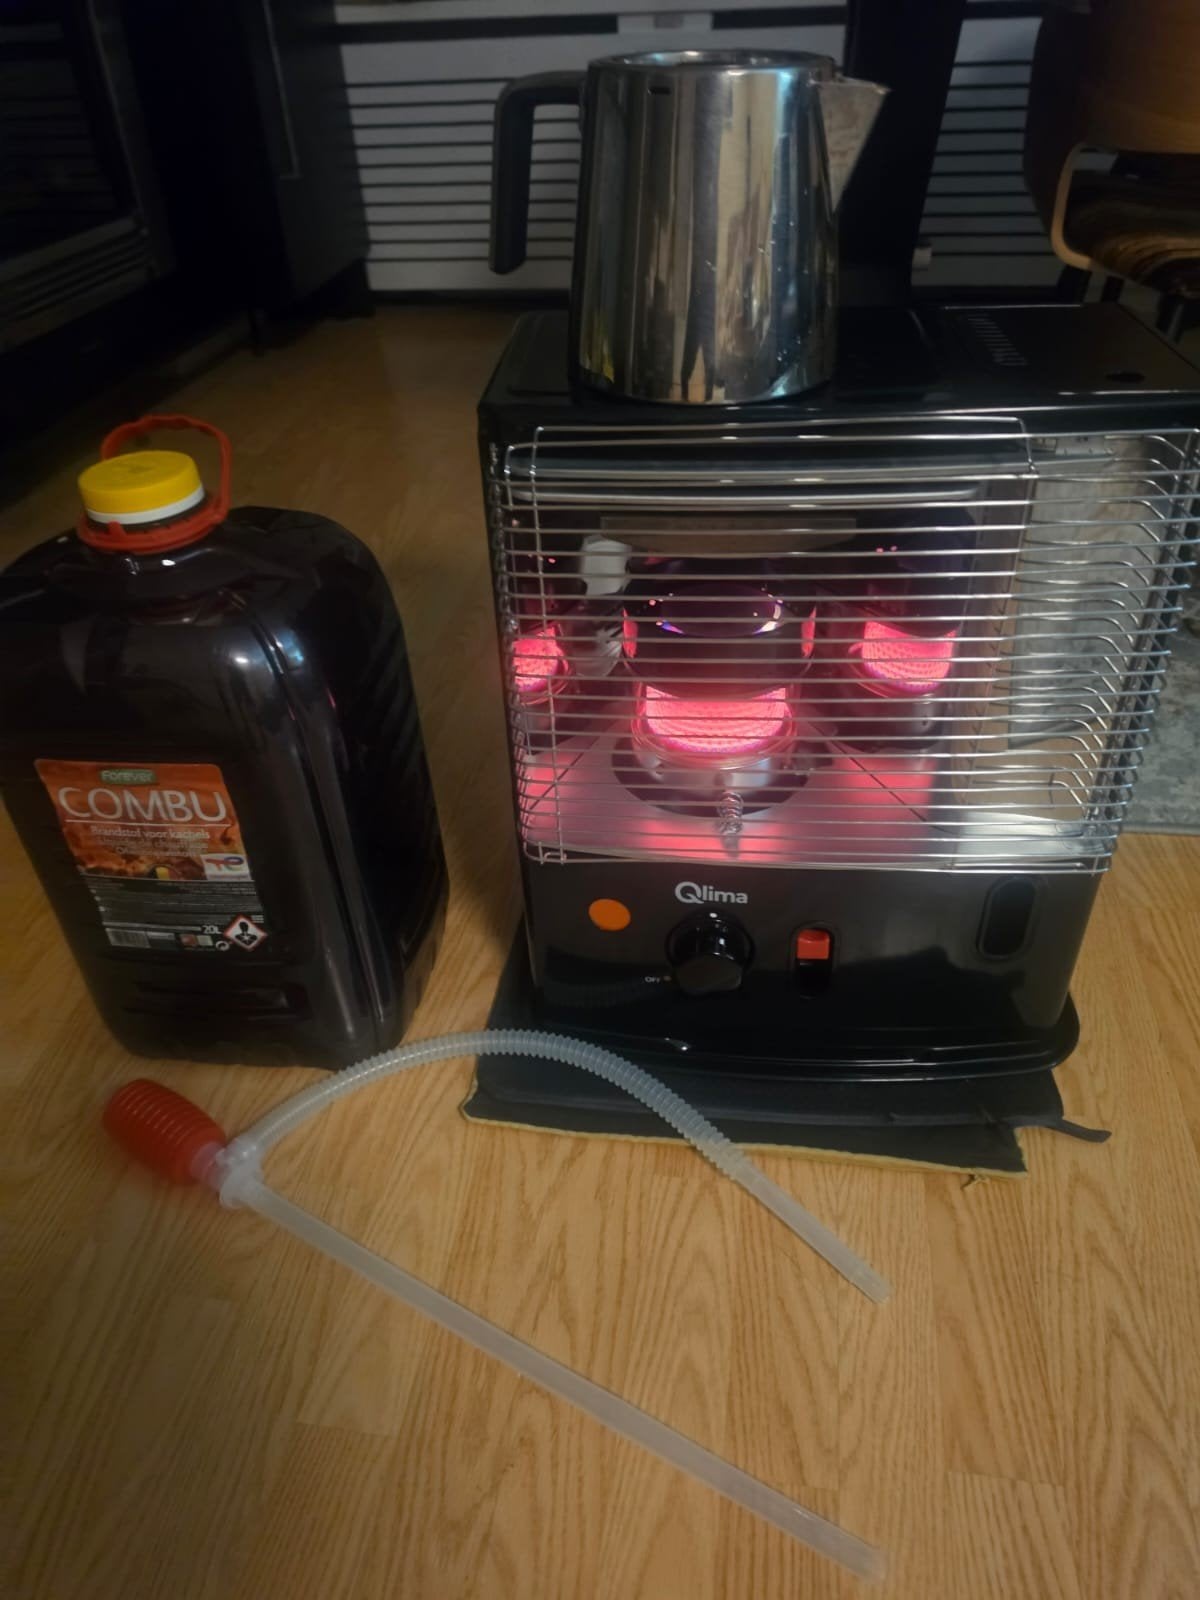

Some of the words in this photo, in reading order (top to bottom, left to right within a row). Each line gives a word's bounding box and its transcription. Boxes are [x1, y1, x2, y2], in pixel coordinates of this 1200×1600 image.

[102, 769, 152, 781] Forever
[58, 786, 227, 822] COMBU
[674, 881, 748, 904] Qlima
